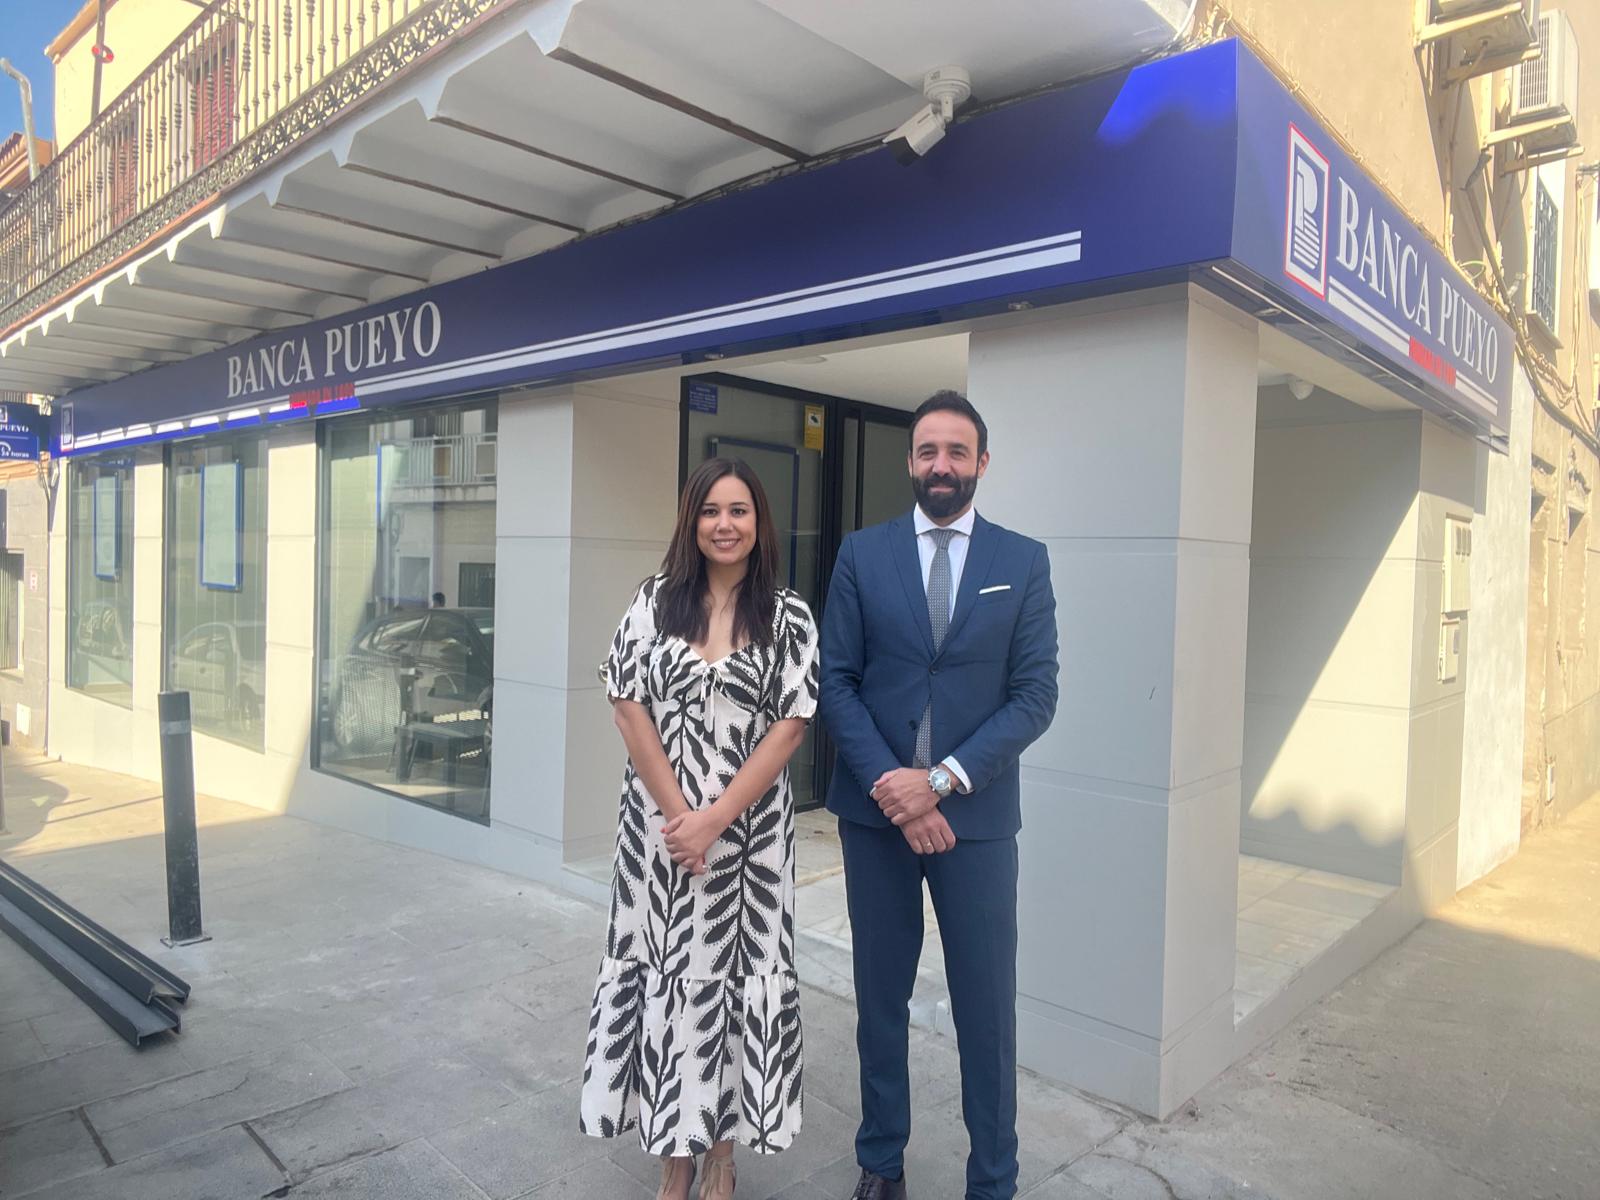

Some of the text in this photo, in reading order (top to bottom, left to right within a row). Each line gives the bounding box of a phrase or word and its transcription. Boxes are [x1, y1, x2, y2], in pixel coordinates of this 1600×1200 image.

[227, 337, 315, 398] BANCA
[324, 301, 441, 378] PUEYO
[1336, 176, 1431, 336] BANCA
[1437, 277, 1498, 384] PUEYO
